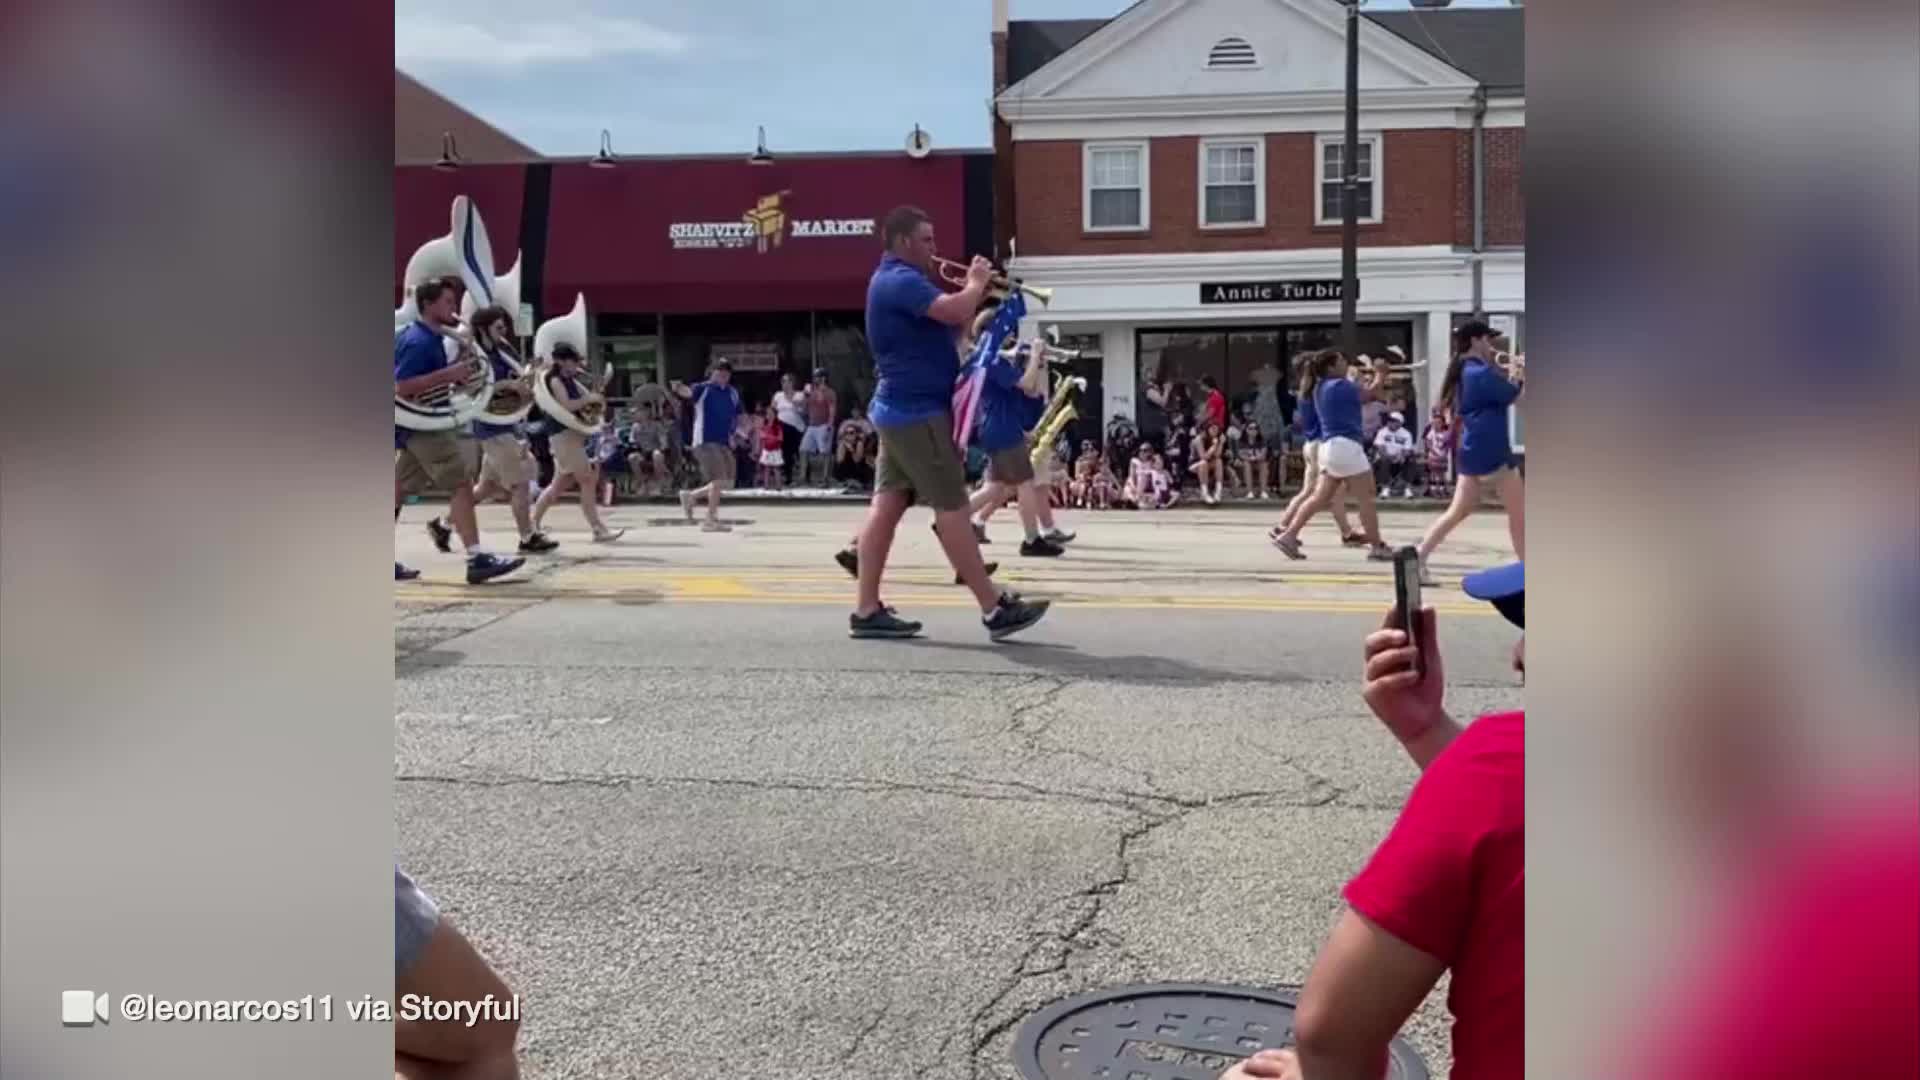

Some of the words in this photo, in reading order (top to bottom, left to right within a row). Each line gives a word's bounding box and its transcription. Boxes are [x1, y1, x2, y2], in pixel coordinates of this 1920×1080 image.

[669, 223, 754, 239] SHAEVITZ
[791, 219, 875, 236] MARKET
[1213, 284, 1272, 300] Annie
